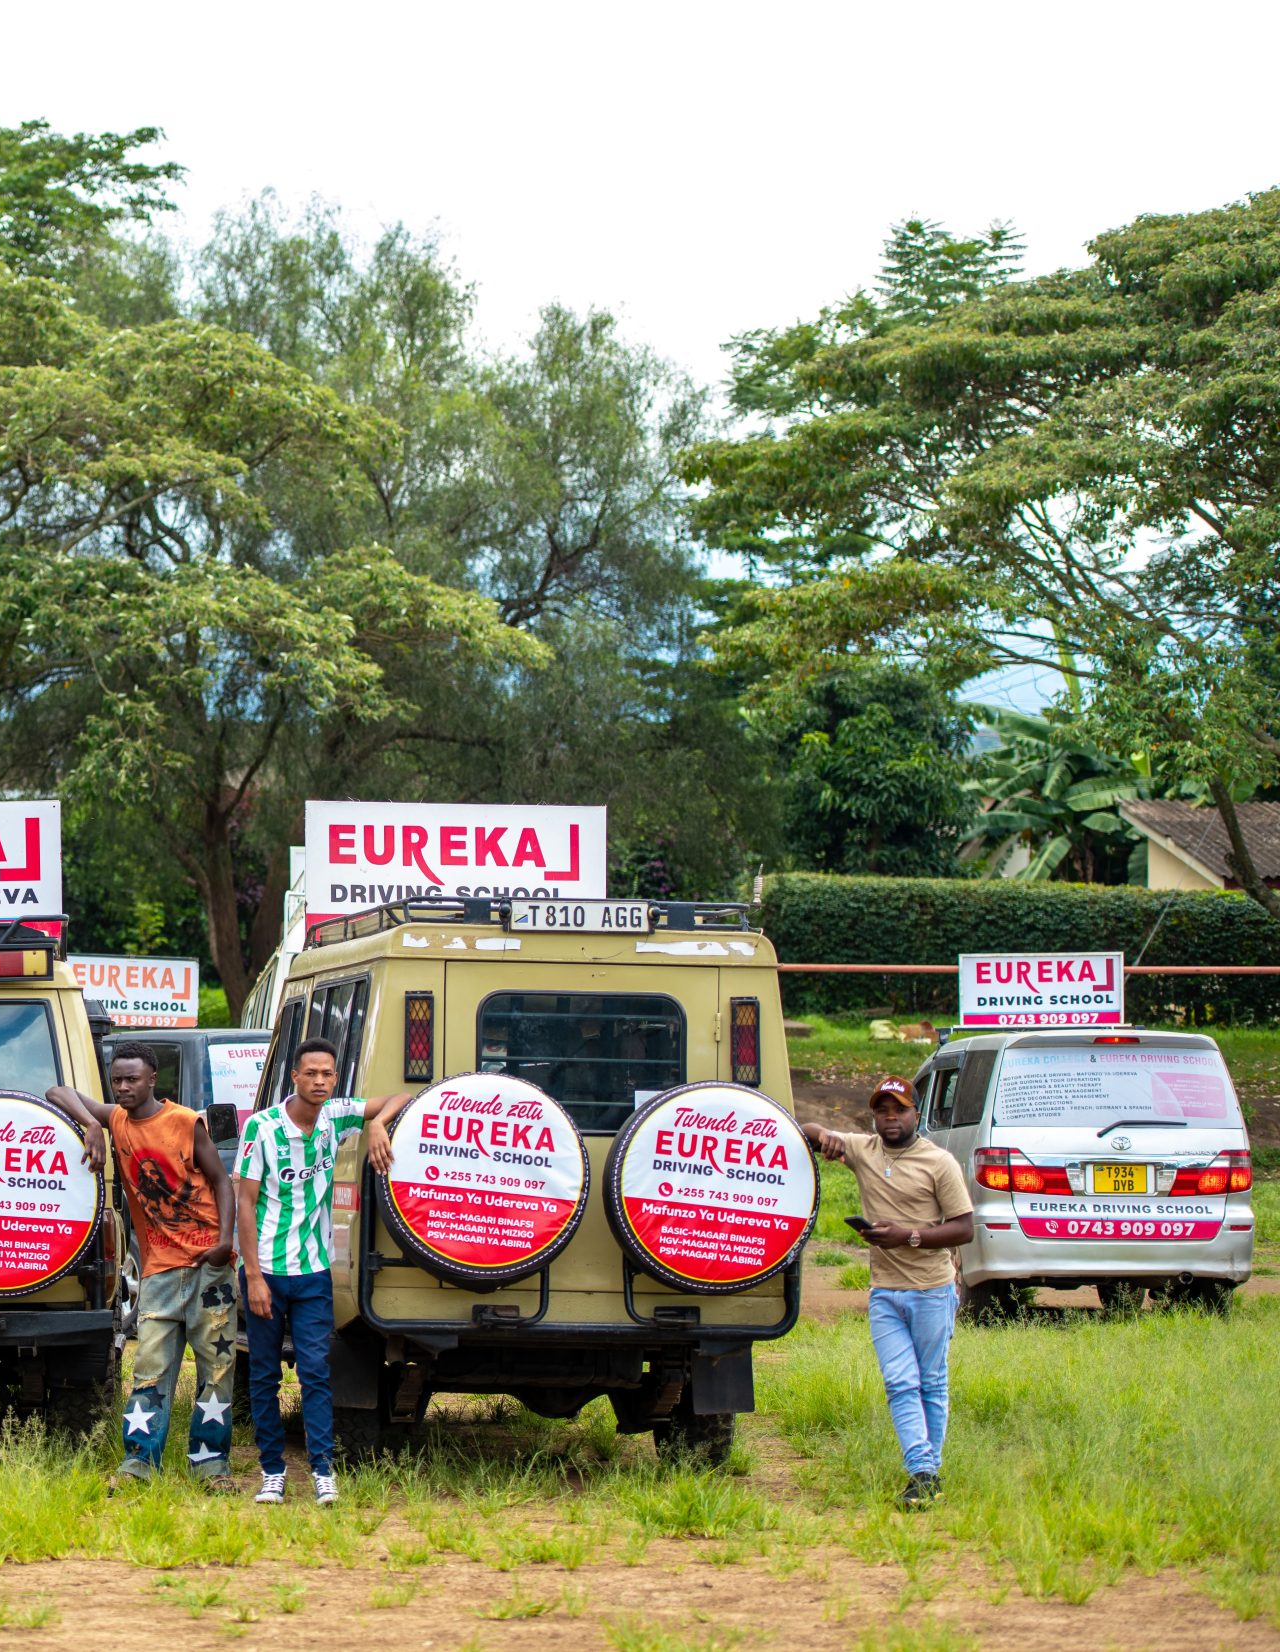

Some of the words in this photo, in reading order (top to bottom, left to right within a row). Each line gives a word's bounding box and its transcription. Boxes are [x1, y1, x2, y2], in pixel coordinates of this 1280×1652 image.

[328, 824, 546, 885] EUREKA
[330, 884, 443, 903] DRIVING
[545, 905, 585, 928] 810
[601, 906, 642, 928] AGG
[73, 964, 176, 998] EUREKA
[976, 960, 1096, 993] EUREKA
[134, 1001, 187, 1012] SCHOOL
[977, 996, 1043, 1006] DRIVING
[1050, 994, 1113, 1005] SCHOOL
[130, 1016, 152, 1026] 909
[155, 1017, 178, 1027] 097
[999, 1014, 1036, 1025] 0743
[1039, 1013, 1068, 1024] 909
[1071, 1013, 1099, 1024] 097
[1090, 1054, 1097, 1063] &
[1100, 1055, 1138, 1063] EUREKA
[1140, 1055, 1180, 1064] DRIVING
[1183, 1056, 1218, 1067] SCHOOL
[439, 1091, 502, 1115] Twende
[507, 1101, 543, 1120] zetu
[674, 1108, 737, 1132] Twende
[741, 1119, 777, 1138] zetu
[20, 1126, 55, 1144] zetu
[422, 1114, 555, 1157] EUREKA
[419, 1144, 480, 1159] DRIVING
[493, 1152, 552, 1167] SCHOOL
[656, 1130, 788, 1174] EUREKA
[298, 1158, 331, 1180] GREE
[653, 1160, 713, 1176] DRIVING
[726, 1169, 785, 1185] SCHOOL
[1107, 1166, 1134, 1179] T934
[8, 1177, 66, 1190] SCHOOL
[444, 1172, 471, 1181] +255
[476, 1174, 496, 1184] 743
[501, 1177, 520, 1187] 909
[525, 1180, 545, 1189] 097
[1113, 1179, 1134, 1191] DYB
[16, 1202, 35, 1211] 909
[40, 1204, 60, 1212] 097
[409, 1186, 463, 1202] Mafunzo
[467, 1193, 482, 1204] Ya
[486, 1195, 538, 1210] Udereva
[542, 1202, 556, 1212] Ya
[678, 1188, 704, 1198] +255
[710, 1191, 729, 1201] 743
[734, 1194, 753, 1204] 909
[758, 1197, 778, 1207] 097
[642, 1202, 696, 1218] Mafunzo
[700, 1209, 714, 1220] Ya
[718, 1212, 770, 1228] Udereva
[774, 1219, 788, 1230] Ya
[1030, 1202, 1087, 1212] EUREKA
[1093, 1204, 1152, 1213] DRIVING
[1157, 1205, 1212, 1215] SCHOOL
[2, 1220, 53, 1233] Udereva
[57, 1224, 72, 1234] Ya
[1067, 1221, 1115, 1235] 0743
[1120, 1222, 1156, 1236] 909
[1160, 1222, 1196, 1236] 097
